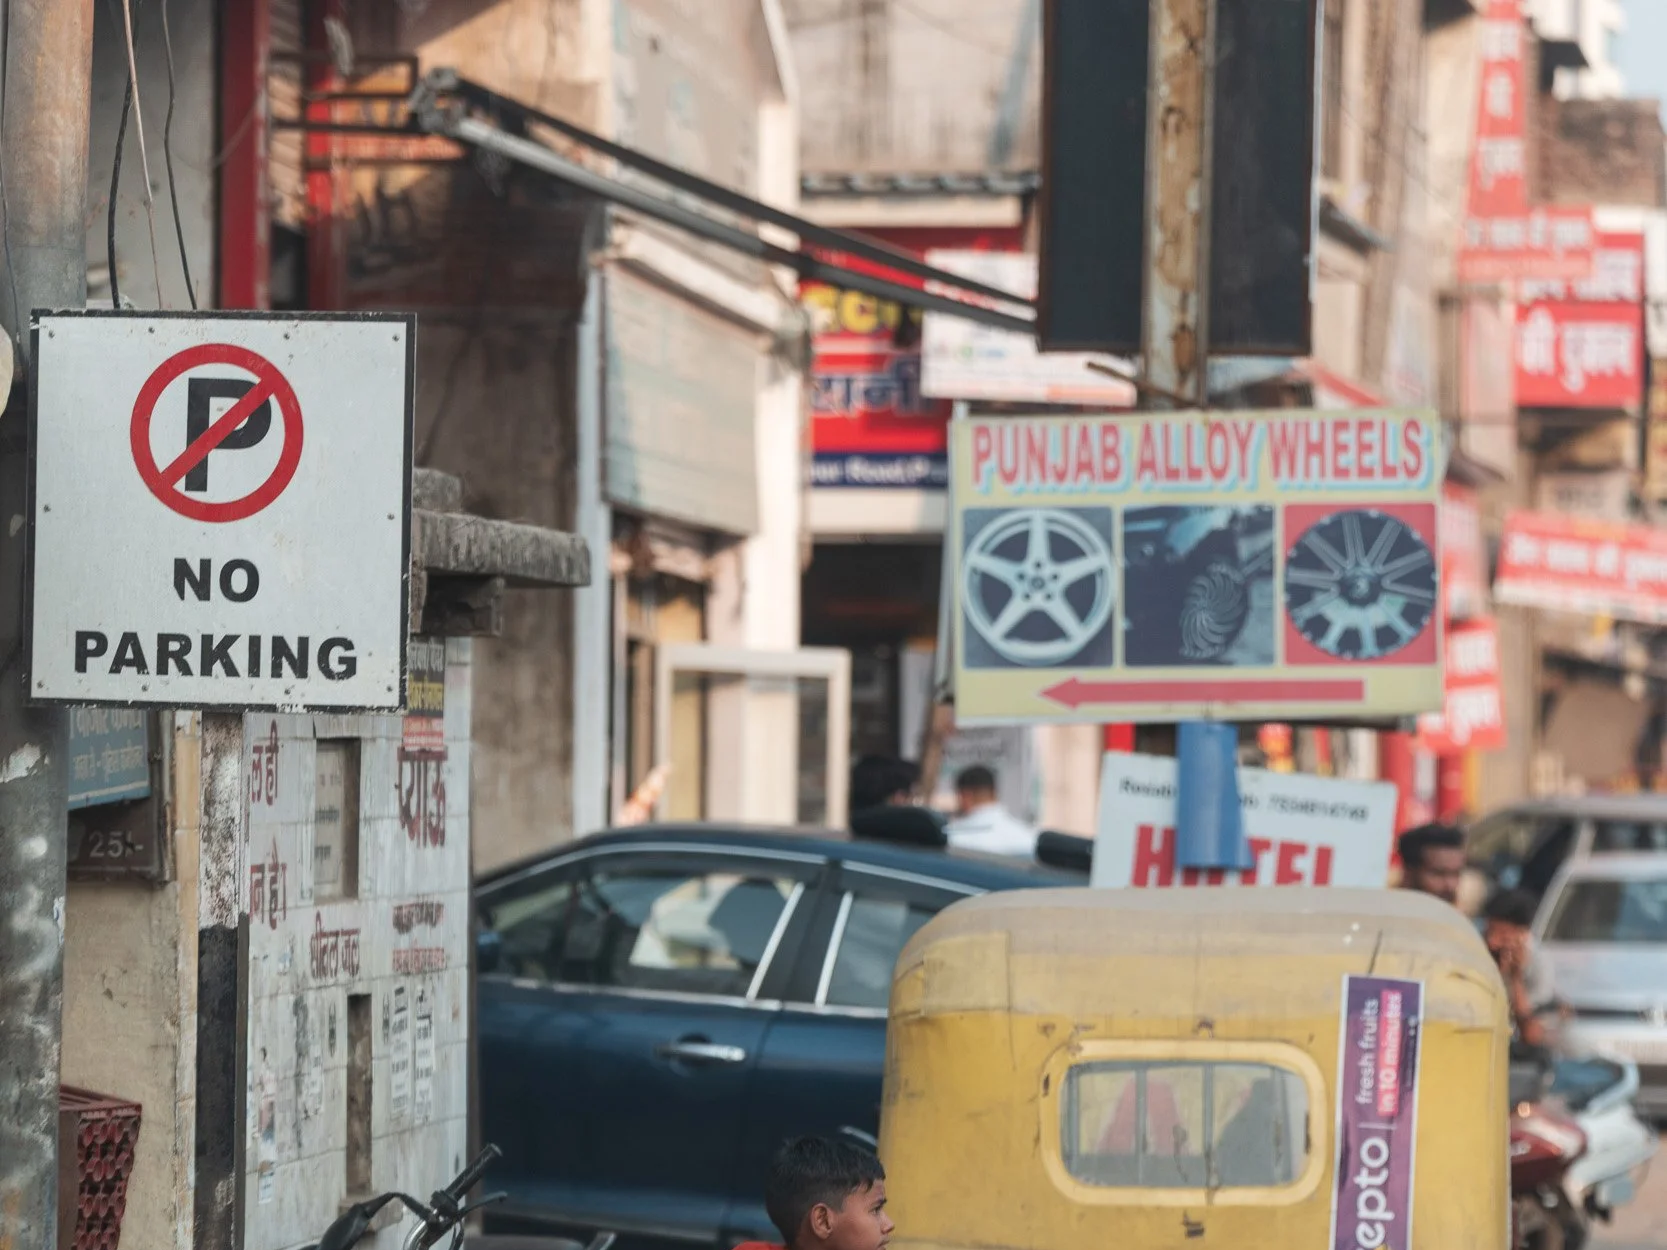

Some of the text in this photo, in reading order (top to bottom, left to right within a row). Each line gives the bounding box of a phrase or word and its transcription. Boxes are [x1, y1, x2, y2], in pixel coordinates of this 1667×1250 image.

[971, 423, 1123, 487] PUNJAB
[1134, 420, 1257, 486] ALLOY
[1266, 417, 1425, 482] WHEELS
[173, 557, 260, 602] NO
[74, 630, 358, 681] PARKING
[1131, 823, 1335, 887] HTEL
[1355, 997, 1380, 1105] fresh fruits
[1381, 991, 1403, 1066] minutes
[1378, 1067, 1397, 1091] 10
